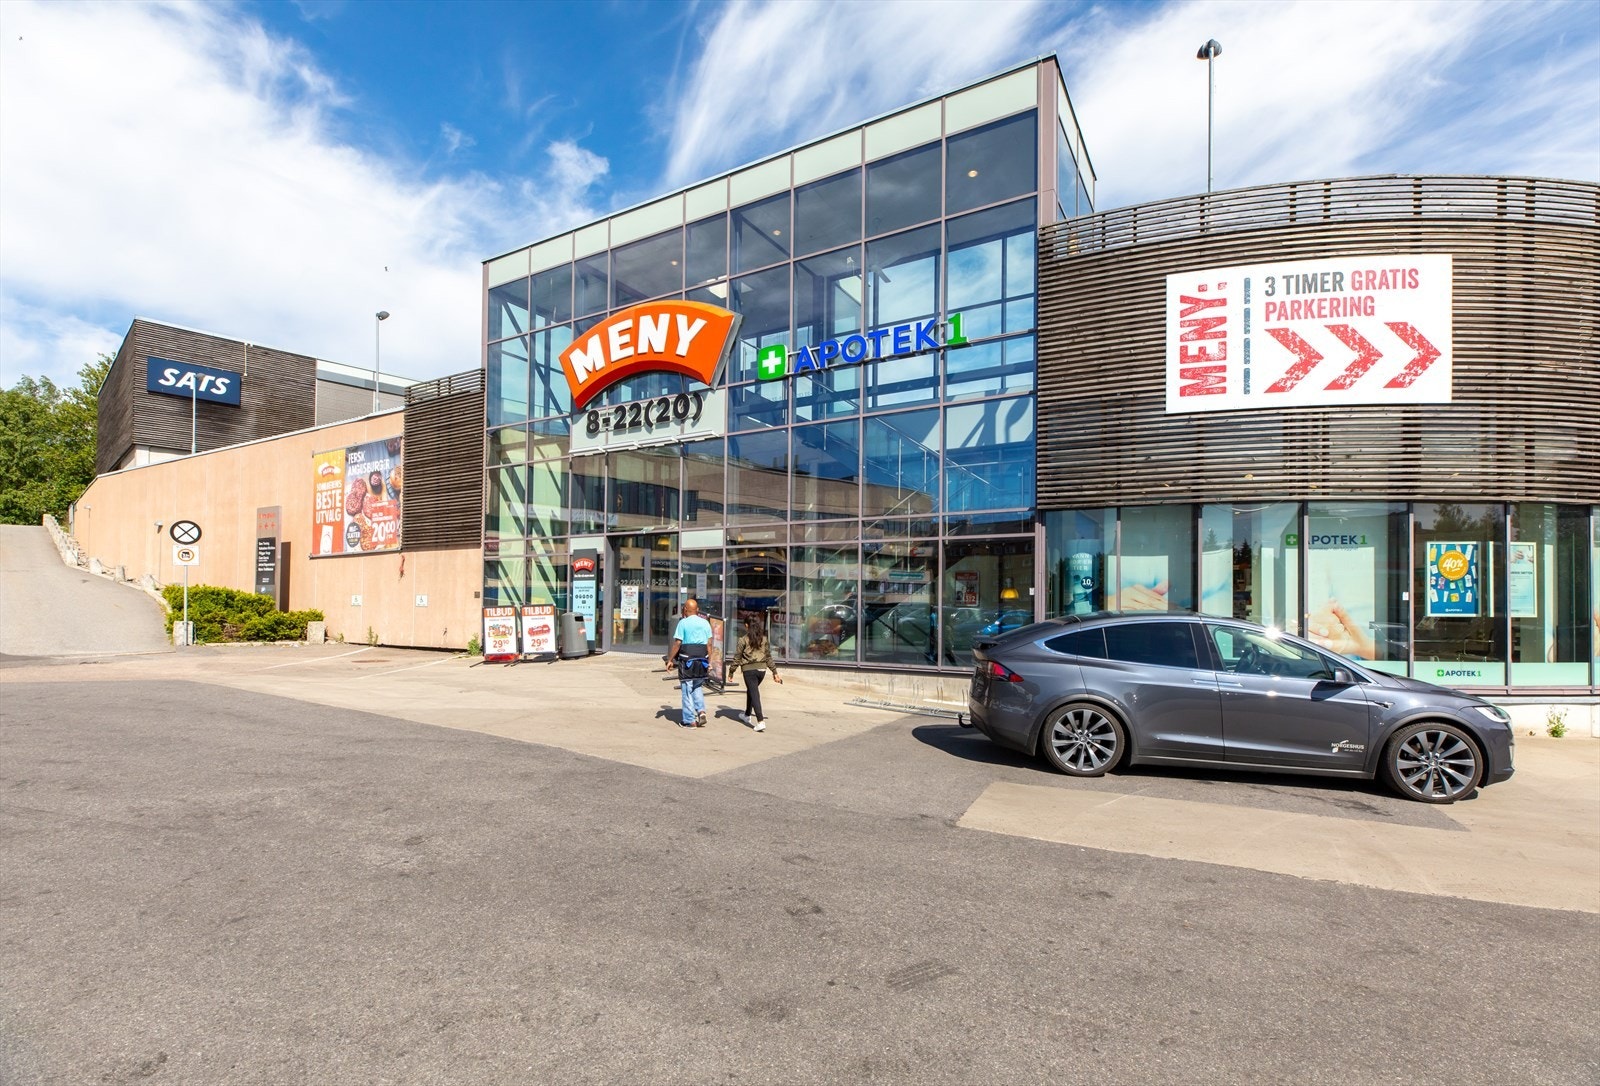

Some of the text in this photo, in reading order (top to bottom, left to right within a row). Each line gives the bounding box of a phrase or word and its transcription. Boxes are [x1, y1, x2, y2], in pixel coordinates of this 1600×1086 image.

[1264, 268, 1420, 297] 3 TIMER GRATIS
[1264, 295, 1376, 322] PARKERING
[569, 313, 708, 385] MENY
[793, 312, 968, 374] APOTEK 1
[1179, 282, 1228, 397] MENY:
[158, 367, 231, 395] SATS
[316, 489, 342, 510] BESTE
[316, 508, 342, 524] UTVALG
[1307, 534, 1368, 545] POTEK 1
[575, 560, 593, 569] MENY
[1442, 557, 1463, 572] 40%
[485, 607, 513, 617] TILBUD
[524, 606, 552, 616] TILBUD
